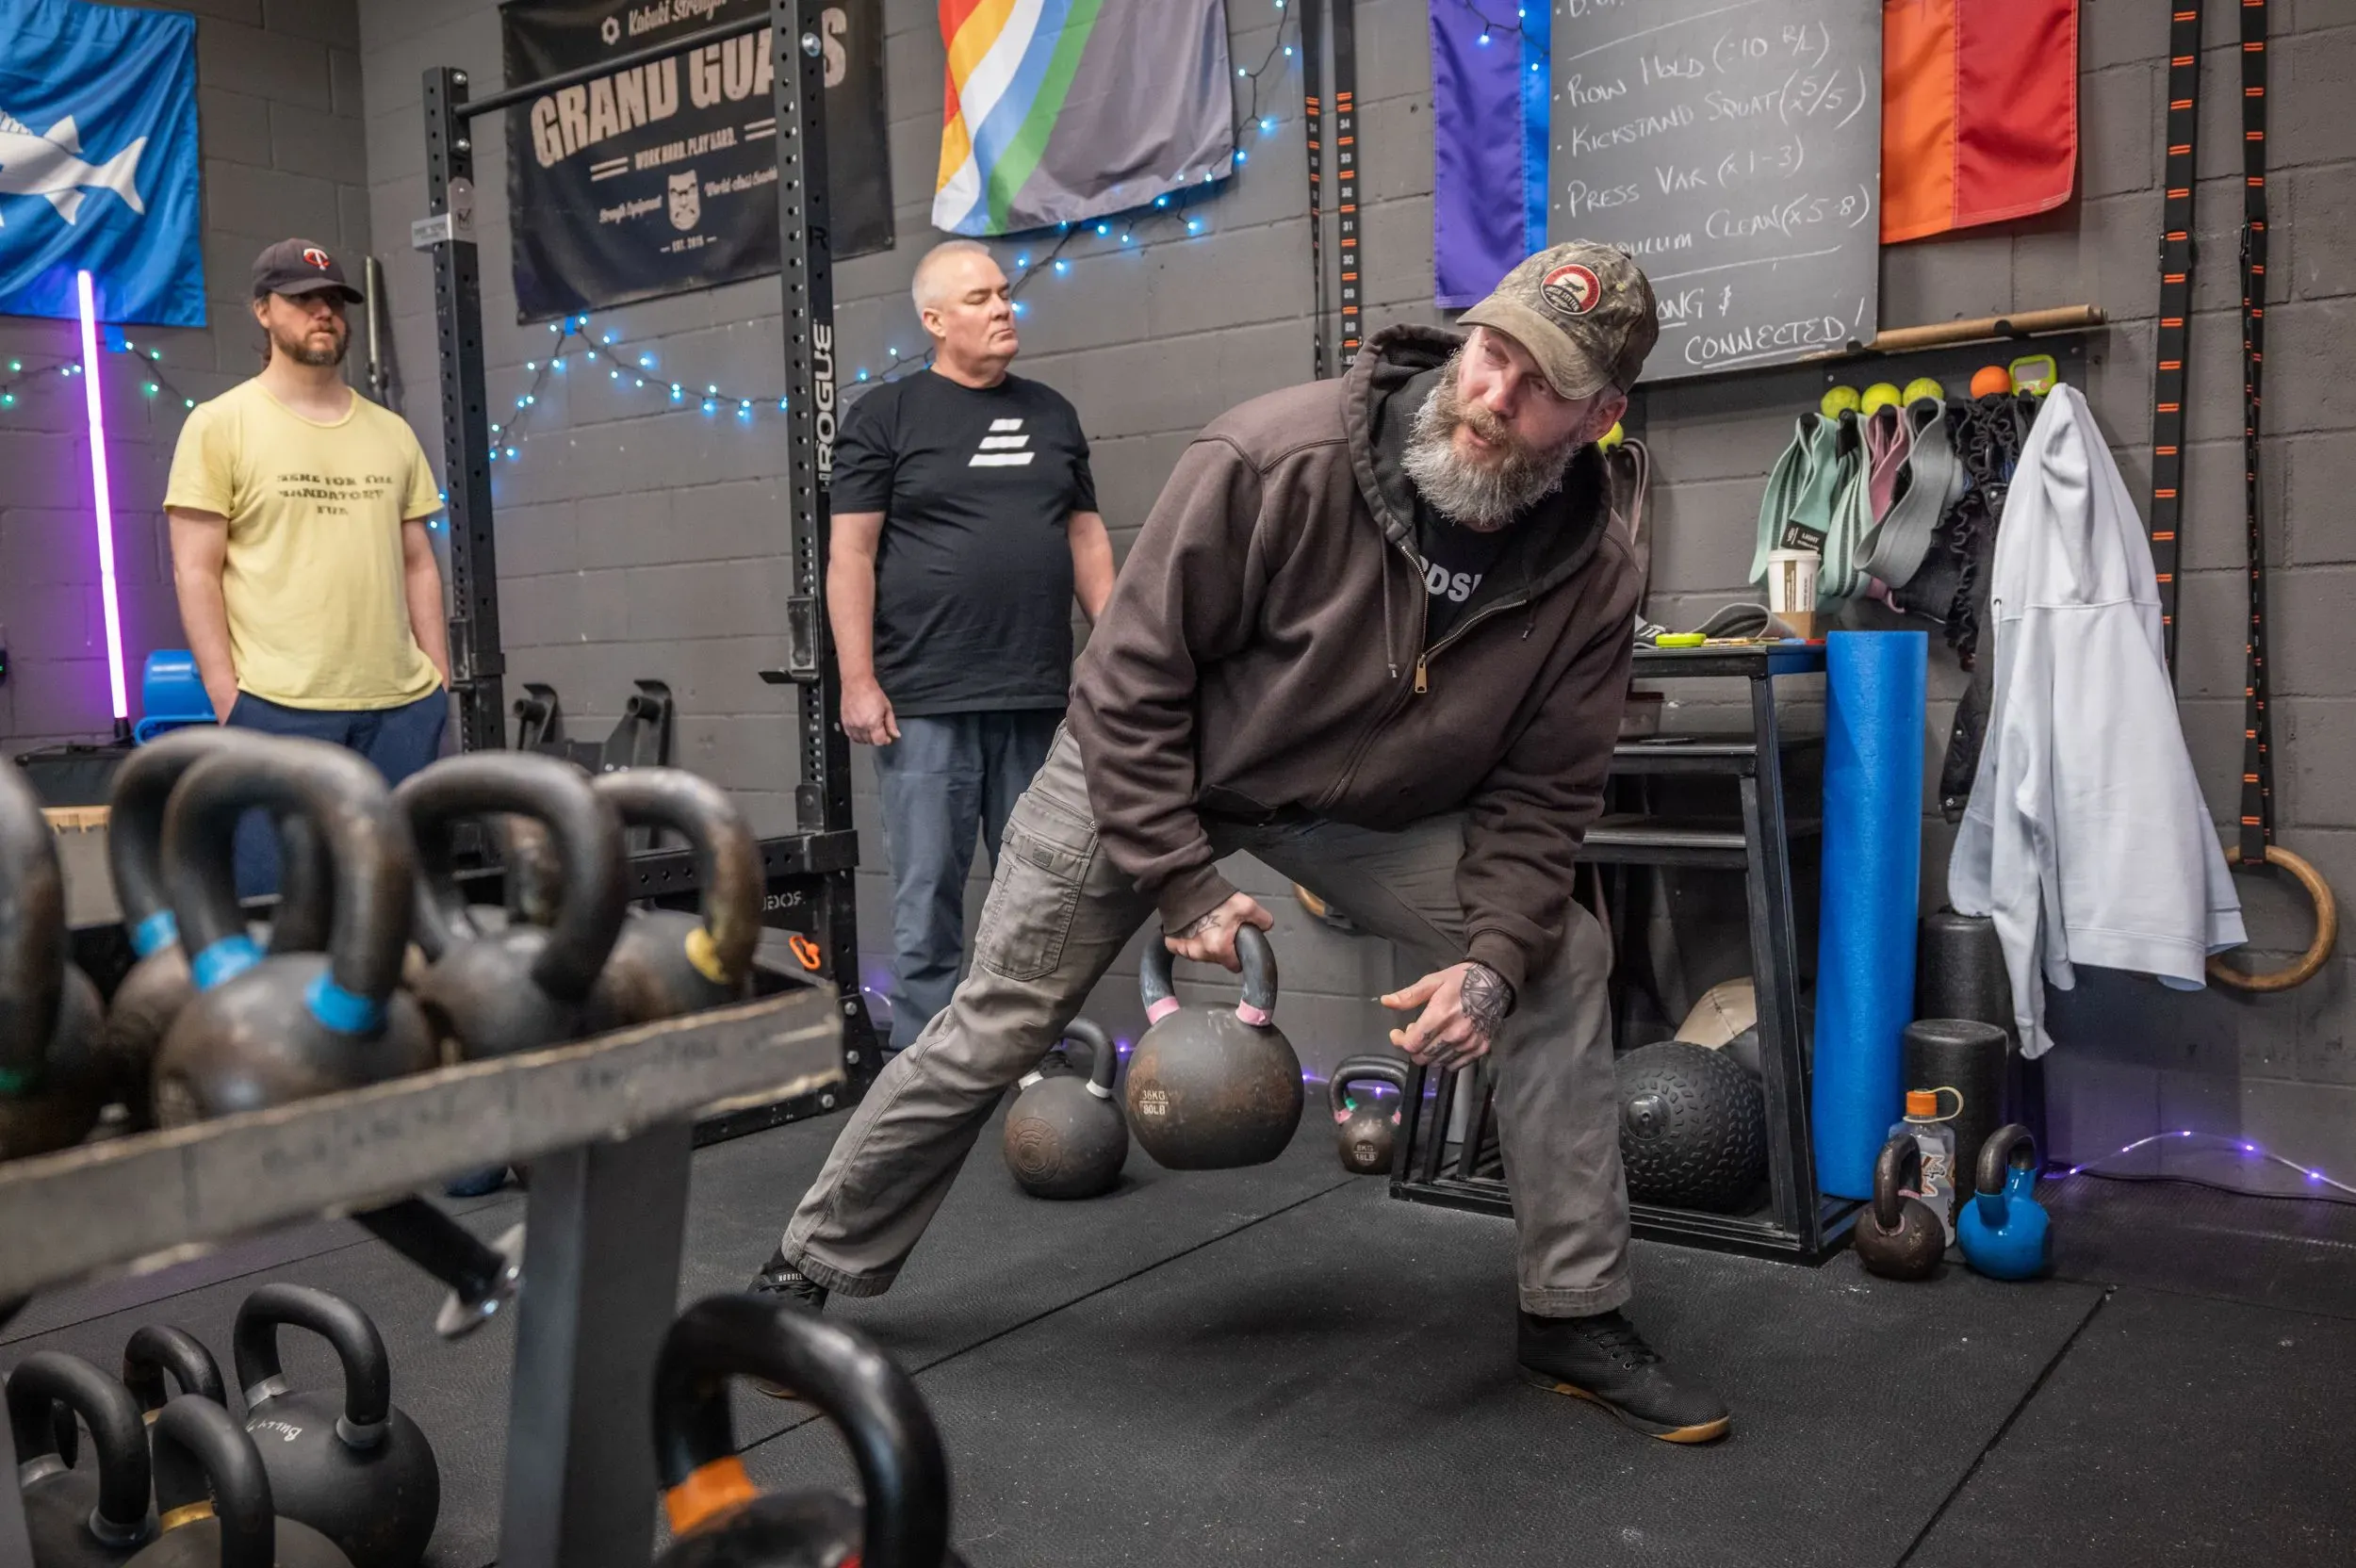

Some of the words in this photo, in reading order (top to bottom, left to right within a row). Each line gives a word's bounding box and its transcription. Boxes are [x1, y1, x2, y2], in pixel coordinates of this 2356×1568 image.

[531, 57, 679, 169] GRAND
[1567, 179, 1640, 218] PRESS
[812, 322, 836, 472] ROGUE
